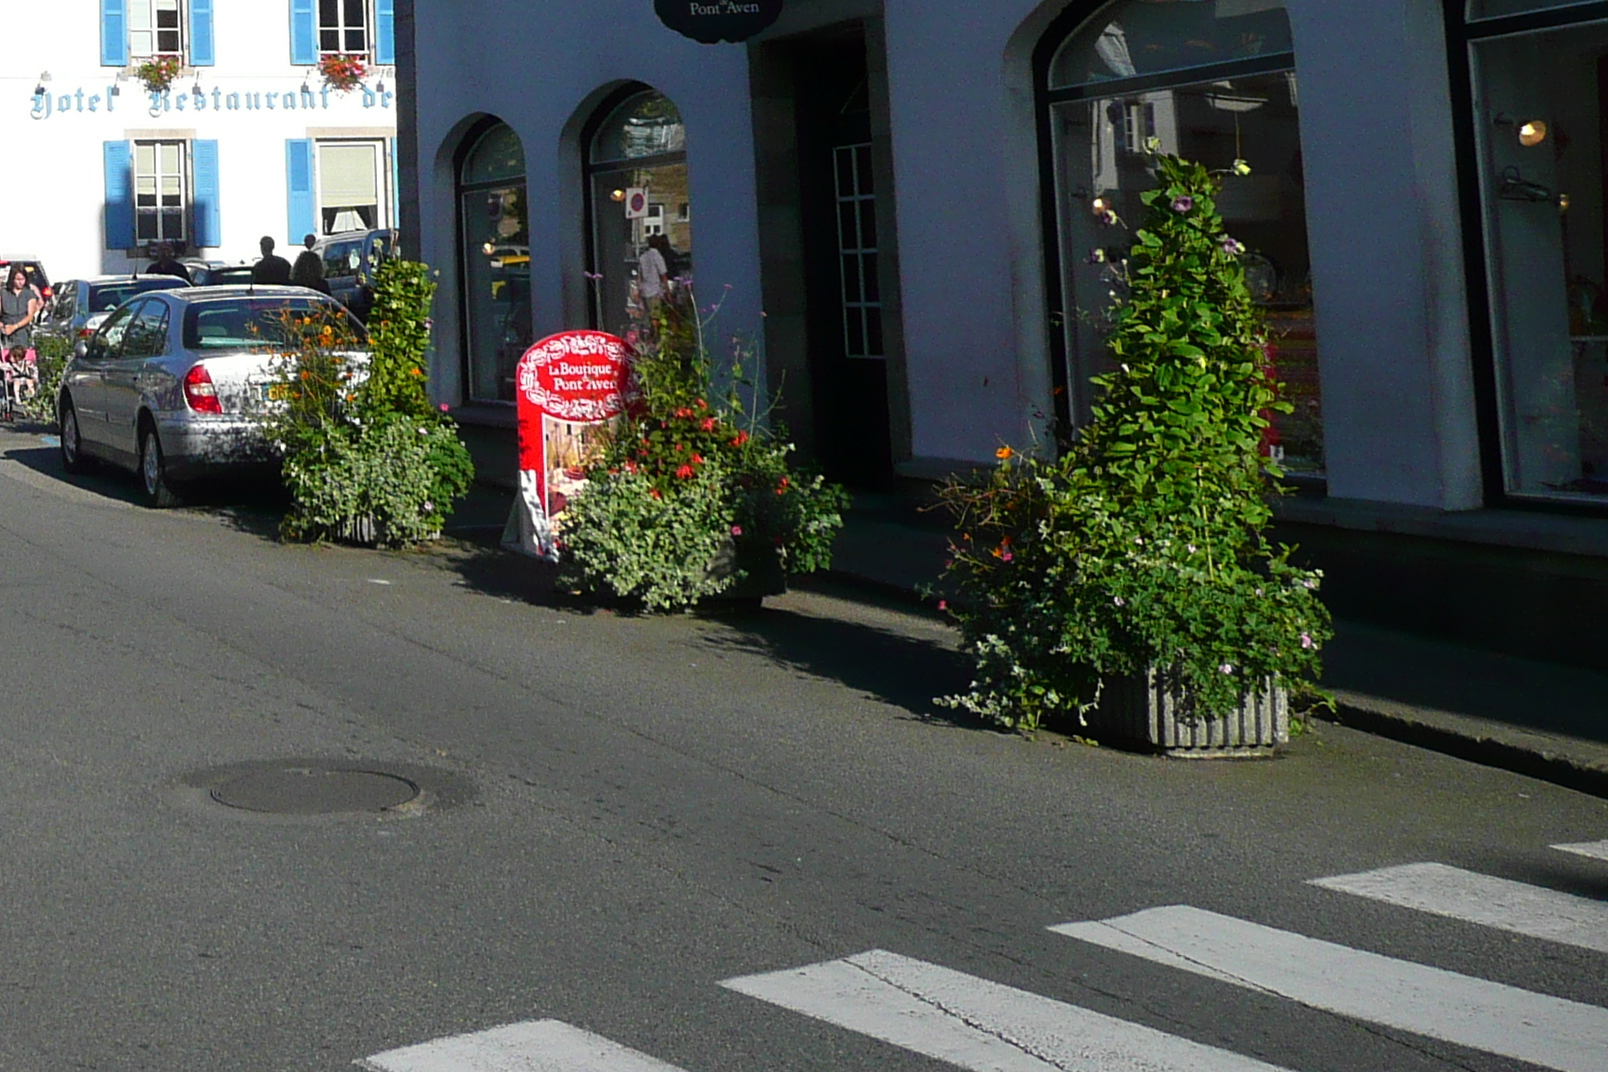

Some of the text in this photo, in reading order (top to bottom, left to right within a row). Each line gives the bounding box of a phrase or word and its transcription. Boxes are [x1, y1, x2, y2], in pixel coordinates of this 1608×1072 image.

[690, 1, 760, 16] Pont Aven
[148, 85, 331, 119] Restaurant
[548, 362, 612, 378] La Boutique
[553, 377, 583, 391] Pont
